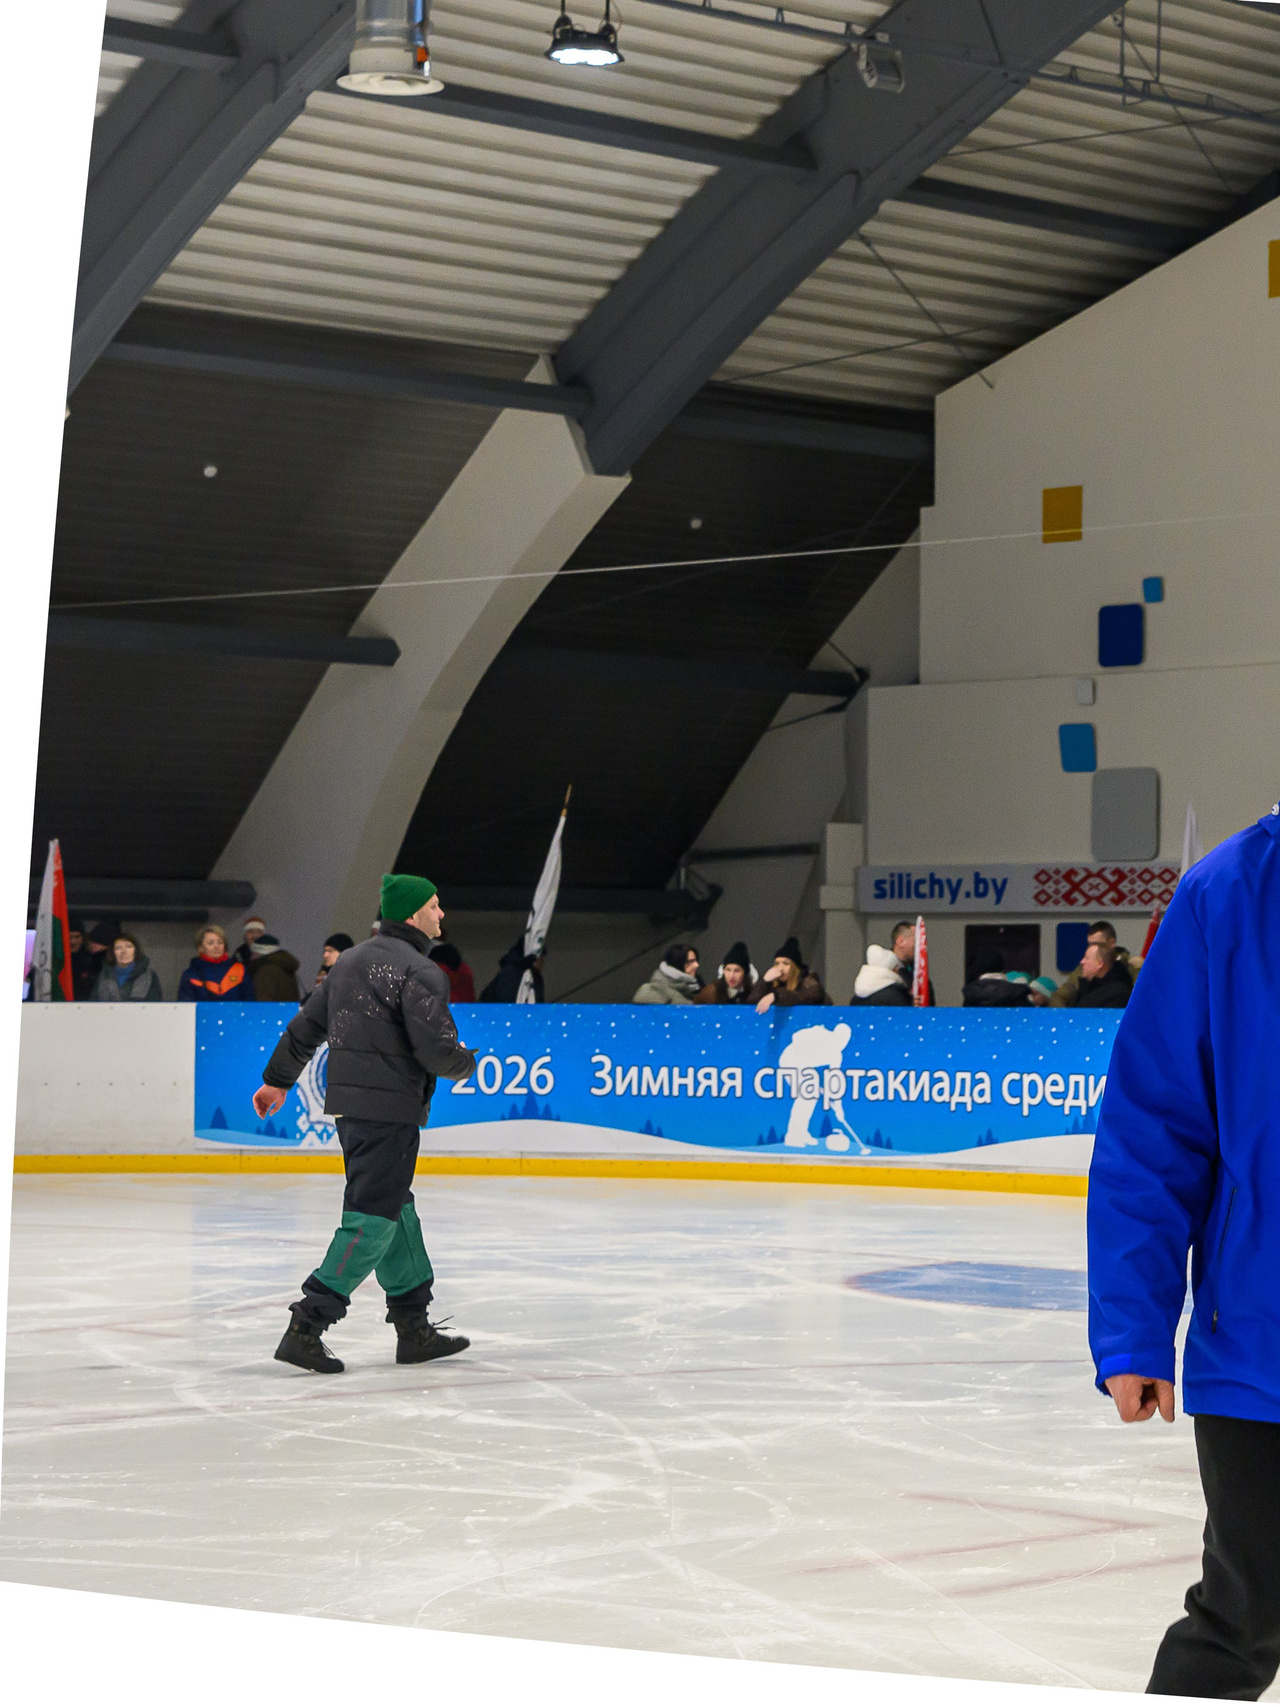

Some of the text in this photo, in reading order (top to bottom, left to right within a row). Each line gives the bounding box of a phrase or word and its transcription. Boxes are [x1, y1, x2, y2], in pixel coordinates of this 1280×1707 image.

[873, 871, 1009, 905] silichy.by
[590, 1054, 743, 1098] Зимняя
[753, 1066, 992, 1112] спартакиада
[1001, 1071, 1107, 1116] среди
